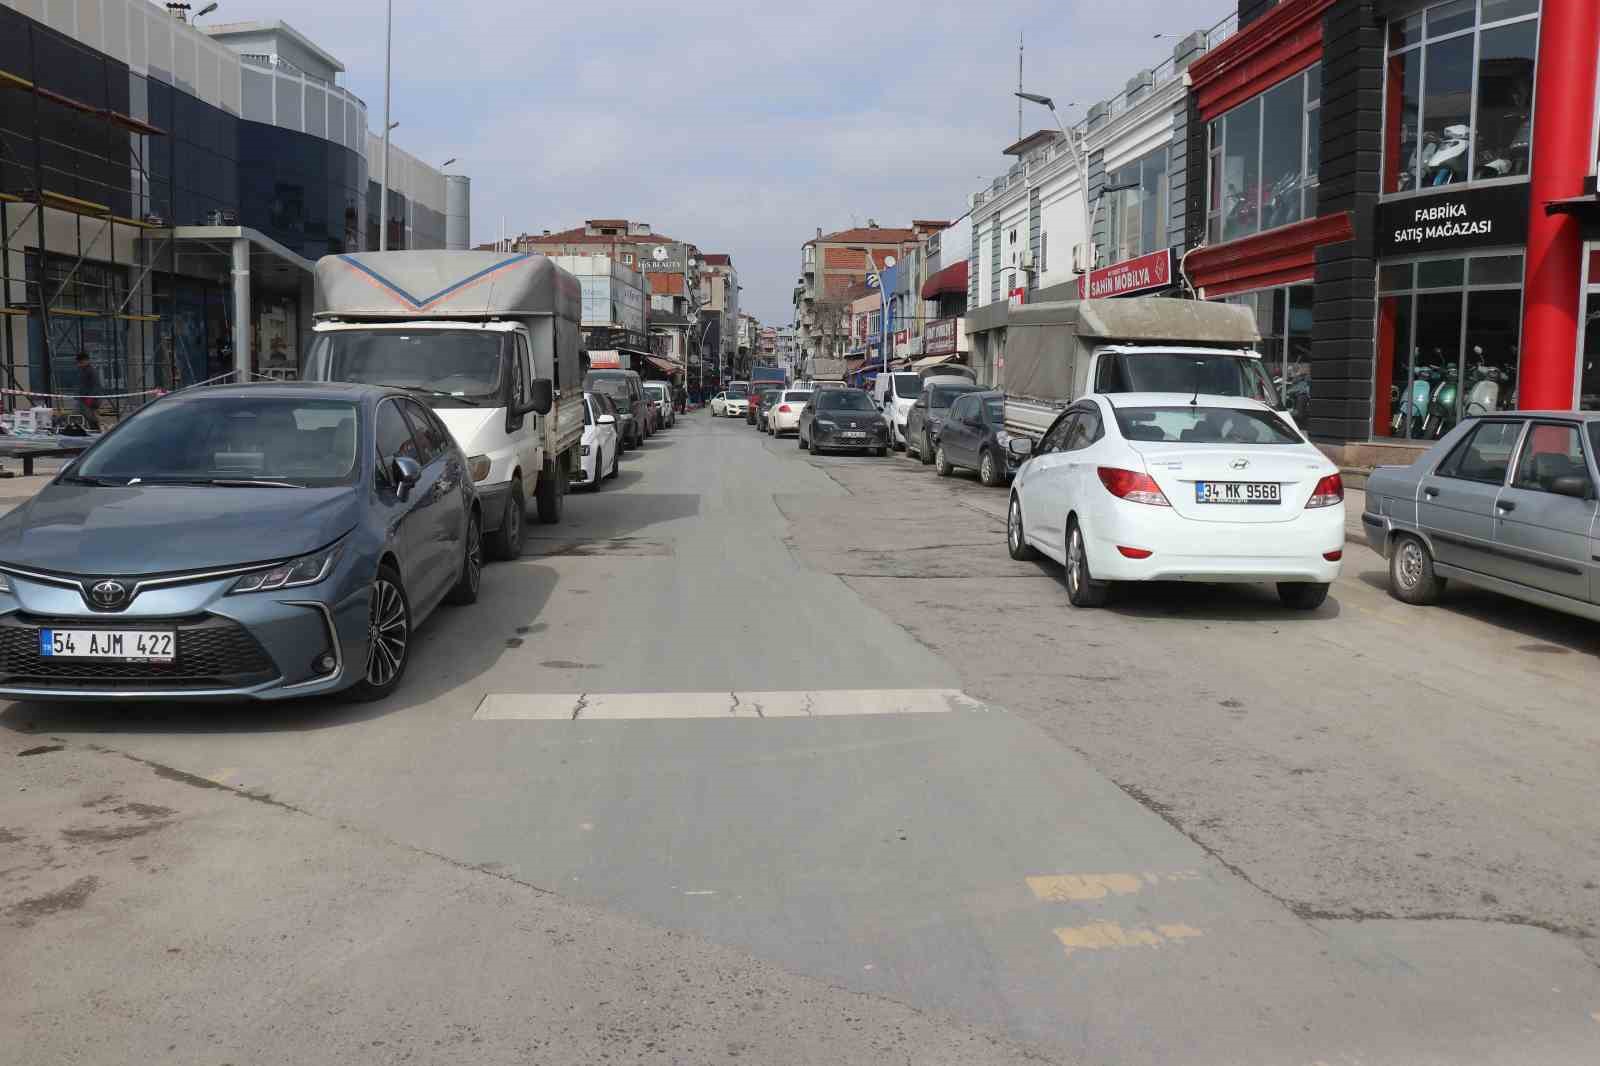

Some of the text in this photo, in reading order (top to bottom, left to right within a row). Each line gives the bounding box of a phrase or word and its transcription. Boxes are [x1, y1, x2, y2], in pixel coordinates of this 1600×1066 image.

[1415, 202, 1467, 222] FABRİKA
[1394, 220, 1492, 243] SATIŞ MAĞAZASI
[1204, 484, 1277, 499] 34 MK 9568
[53, 632, 172, 656] 54 AJM 422
